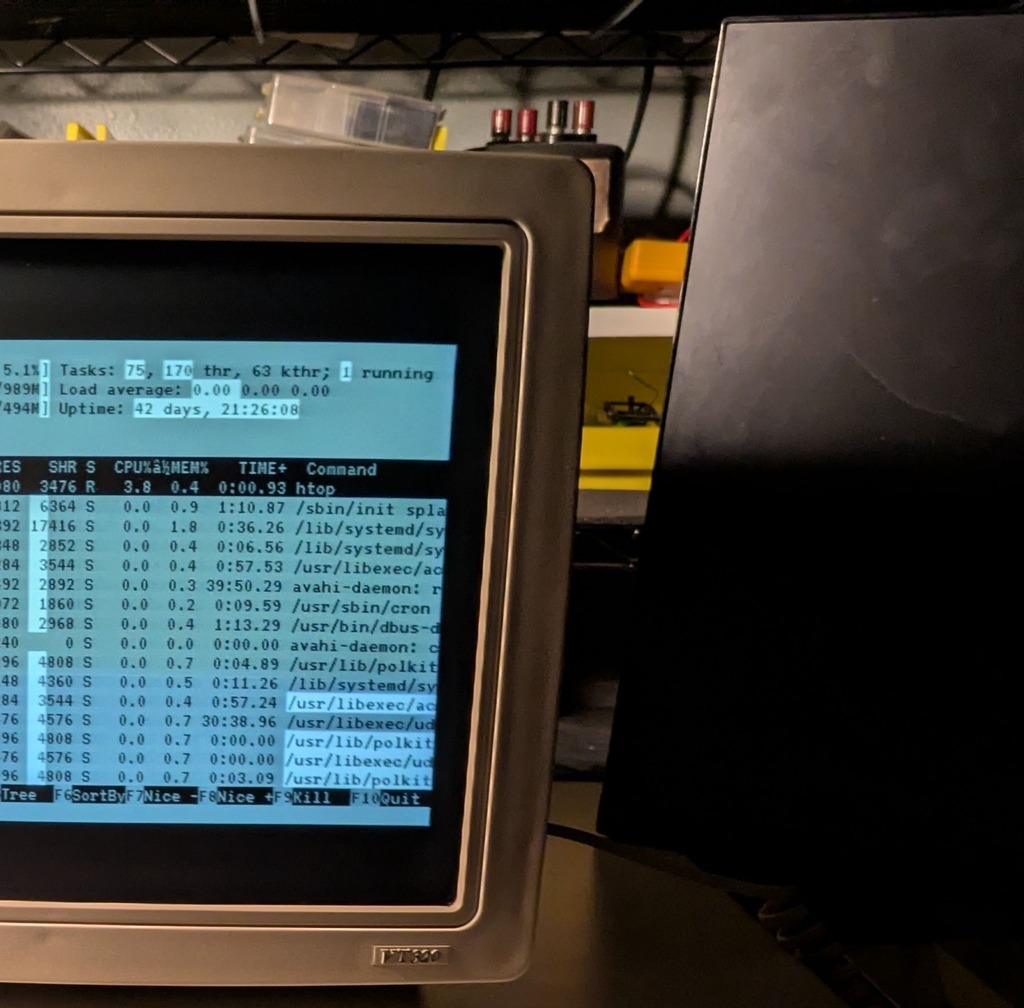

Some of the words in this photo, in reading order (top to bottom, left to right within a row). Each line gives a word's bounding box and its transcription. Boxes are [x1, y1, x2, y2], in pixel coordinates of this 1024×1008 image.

[61, 364, 113, 376] Tasks:
[127, 365, 152, 379] 75,
[166, 365, 192, 376] 170
[204, 365, 240, 379] thr,
[253, 365, 271, 377] 63
[362, 367, 433, 383] running
[61, 384, 96, 395] Load
[108, 386, 180, 398] average:
[194, 384, 230, 396] 0.00
[242, 384, 280, 396] 0.00
[291, 385, 330, 397] 0.00
[59, 402, 122, 417] Uptime:
[135, 403, 152, 414] 42
[164, 403, 209, 418] days,
[222, 403, 298, 415] 21:26:08
[49, 460, 77, 473] SHR
[239, 462, 287, 474] TIME+
[307, 462, 377, 476] Command
[40, 480, 76, 493] 3476
[124, 480, 151, 493] 3.8
[171, 481, 199, 493] 0.4
[219, 481, 286, 494] 0:00.93
[296, 482, 336, 498] htop
[219, 501, 284, 514] 1:10.87
[297, 501, 393, 516] /sbin/init
[407, 504, 445, 519] spla
[217, 560, 282, 573] 0:57.53
[207, 580, 282, 592] 39:50.29
[293, 581, 418, 594] avahi-daemon:
[216, 599, 281, 612] 0:09.59
[292, 599, 430, 615] /usr/sbin/cron
[215, 619, 280, 631] 1:13.29
[291, 640, 416, 653] avahi-daemon:
[214, 658, 279, 670] 0:04.89
[202, 715, 276, 727] 30:38.96
[210, 772, 274, 784] 0:03.09
